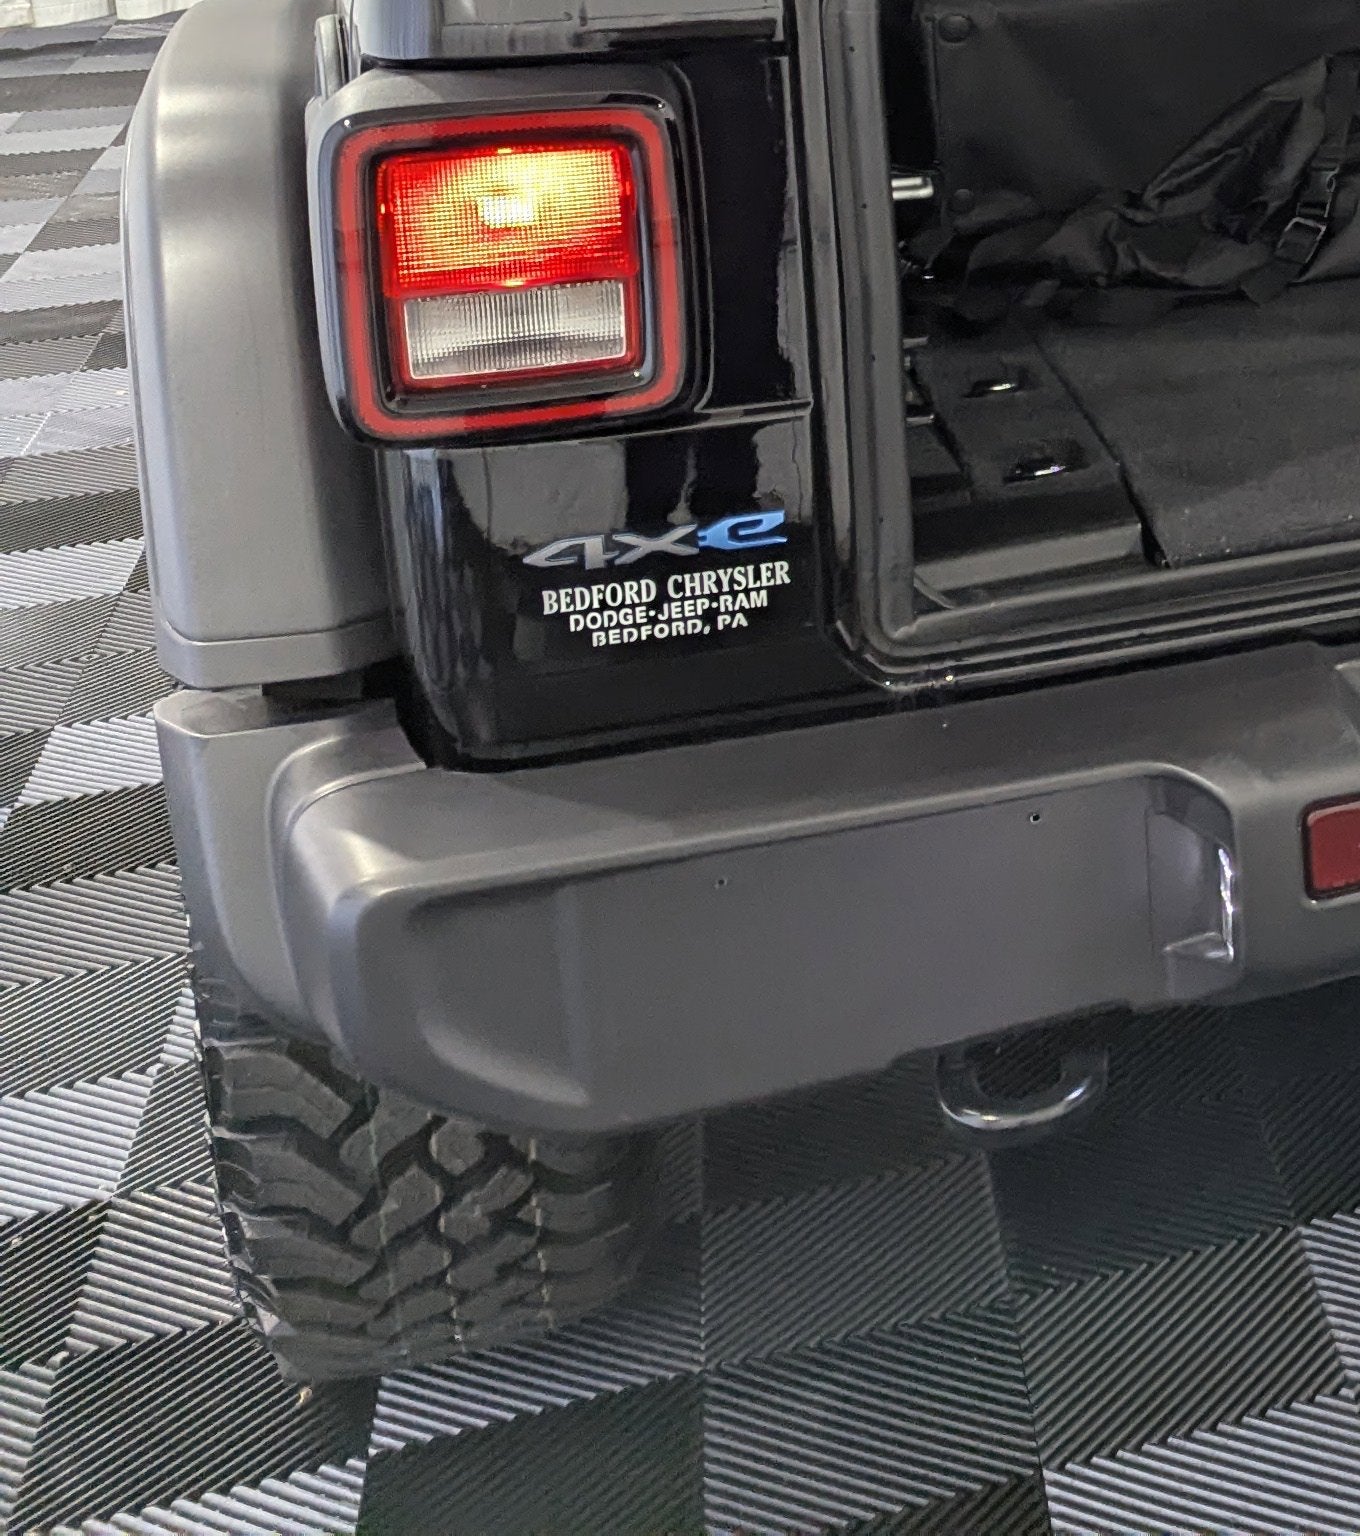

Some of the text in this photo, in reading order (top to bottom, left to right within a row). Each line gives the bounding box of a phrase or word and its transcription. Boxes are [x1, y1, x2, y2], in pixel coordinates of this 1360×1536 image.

[541, 560, 792, 615] BEDFORD CHRYSLER
[592, 613, 749, 648] BEDFORD, PA
